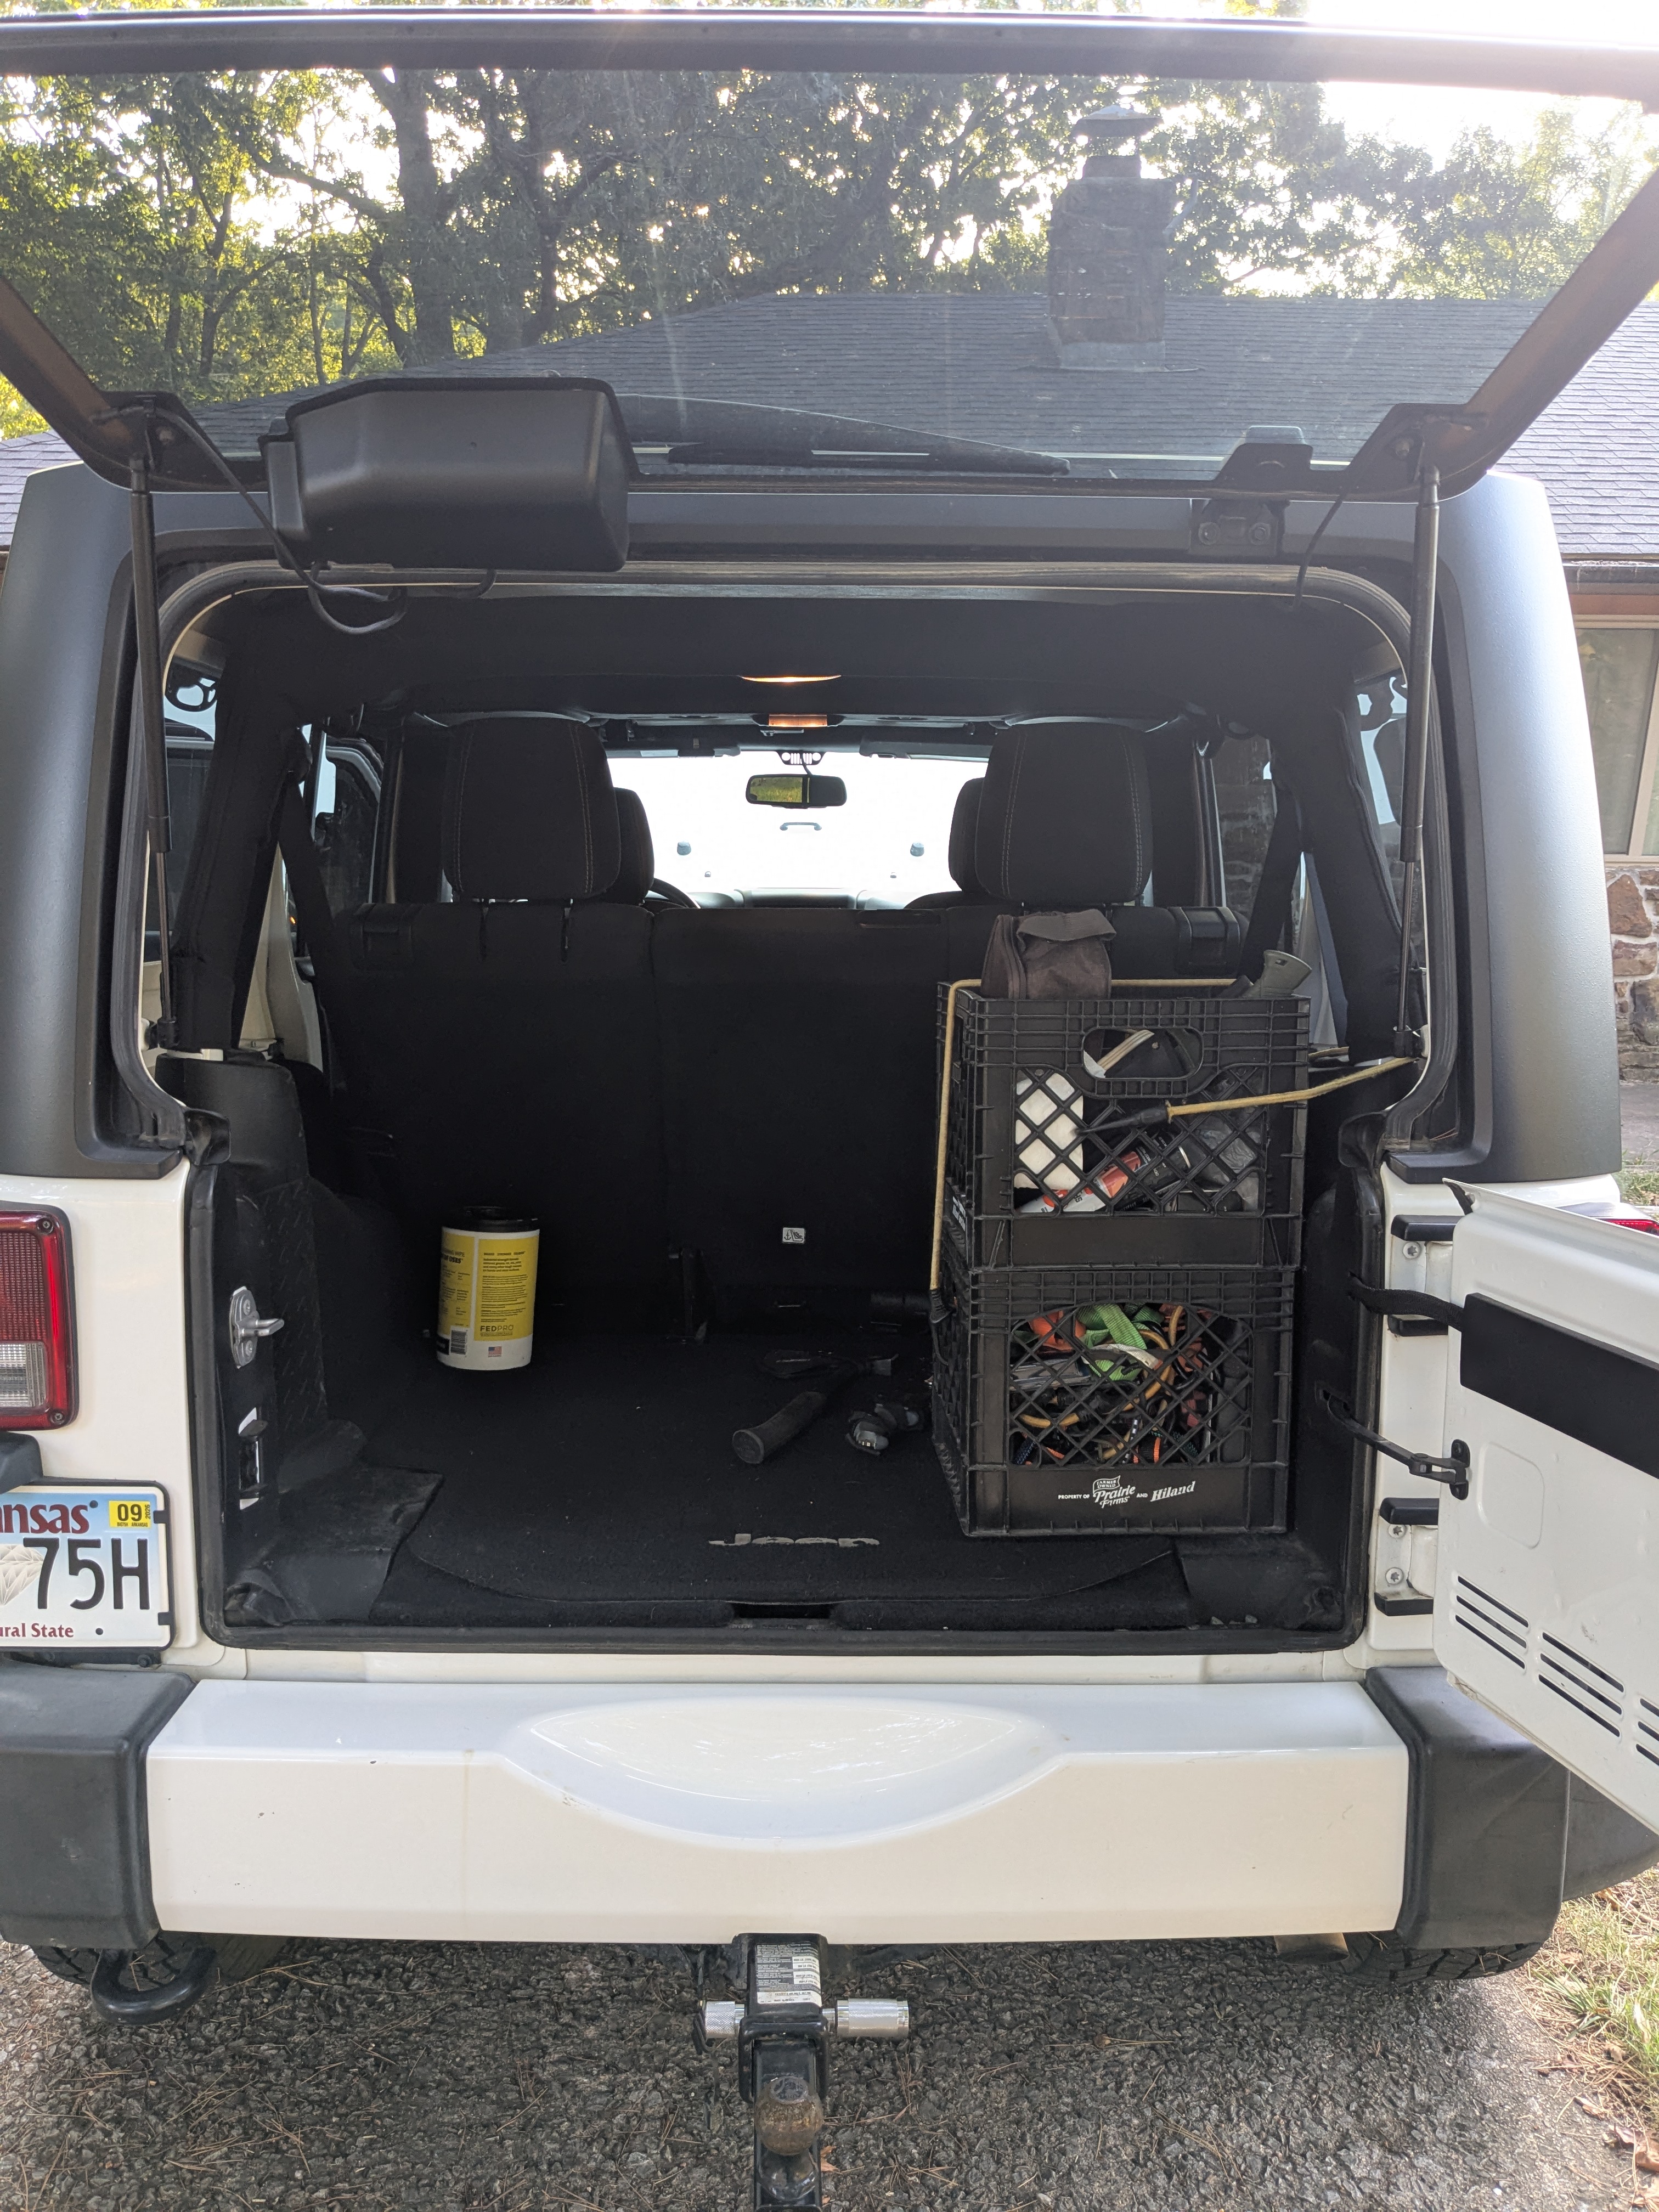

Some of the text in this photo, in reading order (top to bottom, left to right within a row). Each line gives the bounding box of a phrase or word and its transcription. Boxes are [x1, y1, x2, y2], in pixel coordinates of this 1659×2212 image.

[1093, 1485, 1136, 1503] Prairie
[1150, 1481, 1195, 1502] Hiland
[1099, 1496, 1128, 1509] Farms
[0, 1504, 89, 1534] nsas
[117, 1504, 142, 1521] 09
[23, 1537, 150, 1610] 75H
[31, 1623, 74, 1638] State
